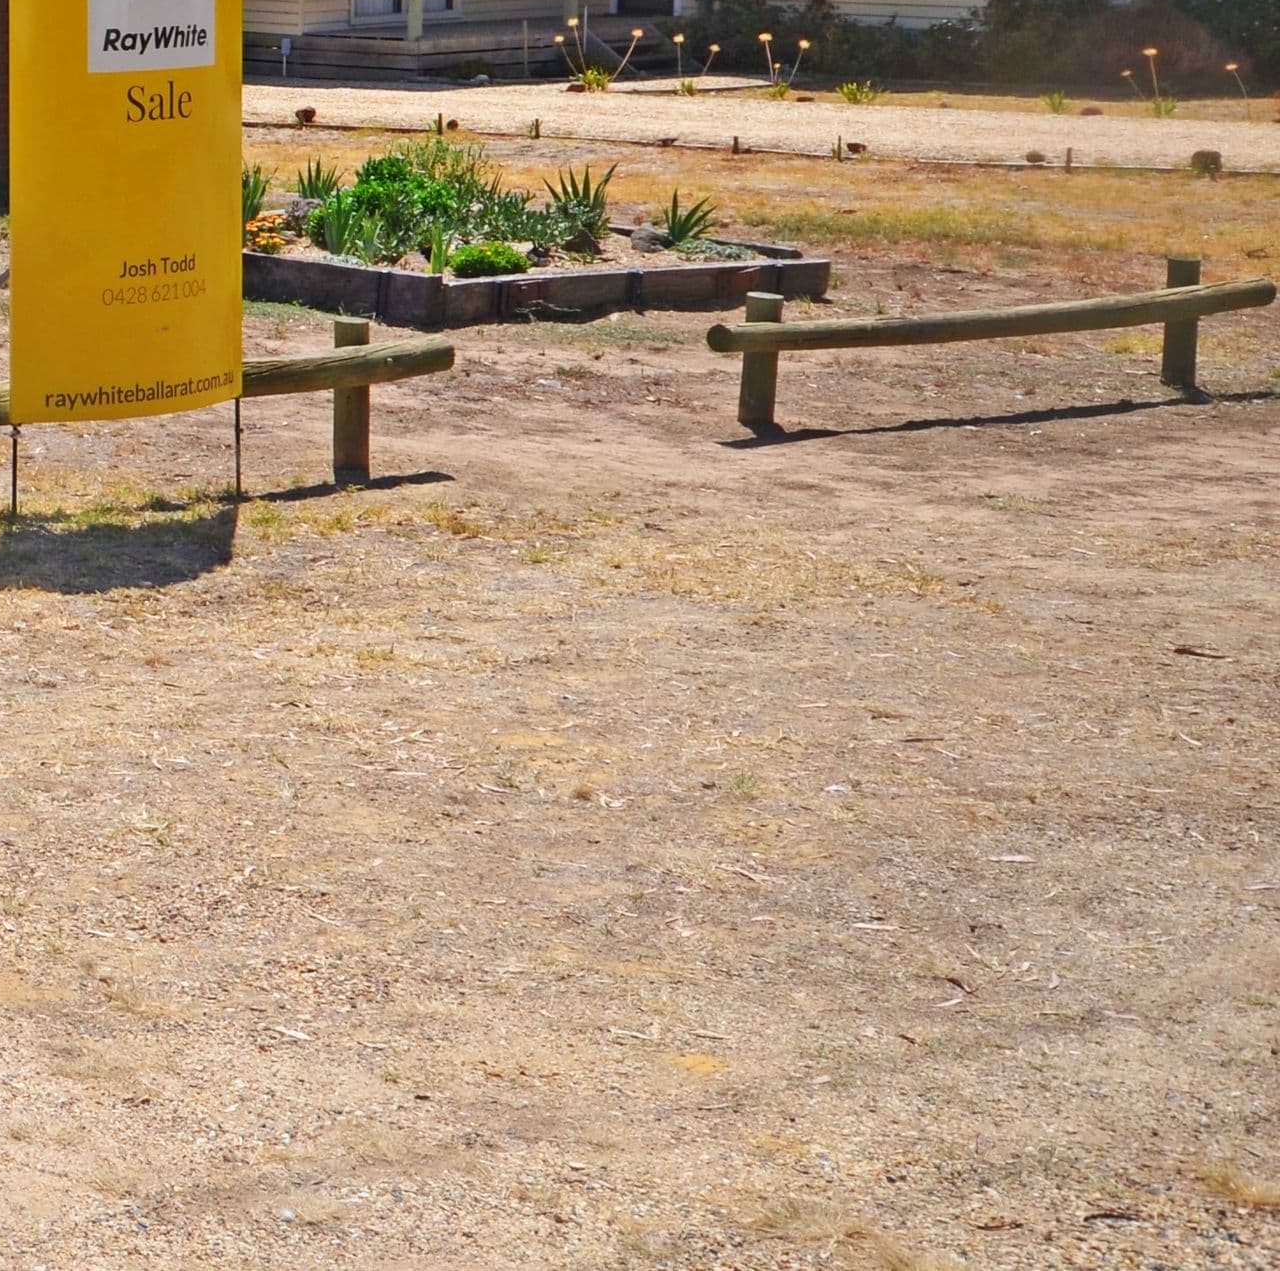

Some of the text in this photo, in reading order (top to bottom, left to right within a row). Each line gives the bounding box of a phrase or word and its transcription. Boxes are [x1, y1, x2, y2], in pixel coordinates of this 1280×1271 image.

[126, 81, 192, 123] Sale
[120, 253, 196, 278] Josh Todd
[102, 286, 147, 306] 0428
[151, 282, 180, 302] 621
[45, 370, 234, 410] raywhiteballarat.com.au
